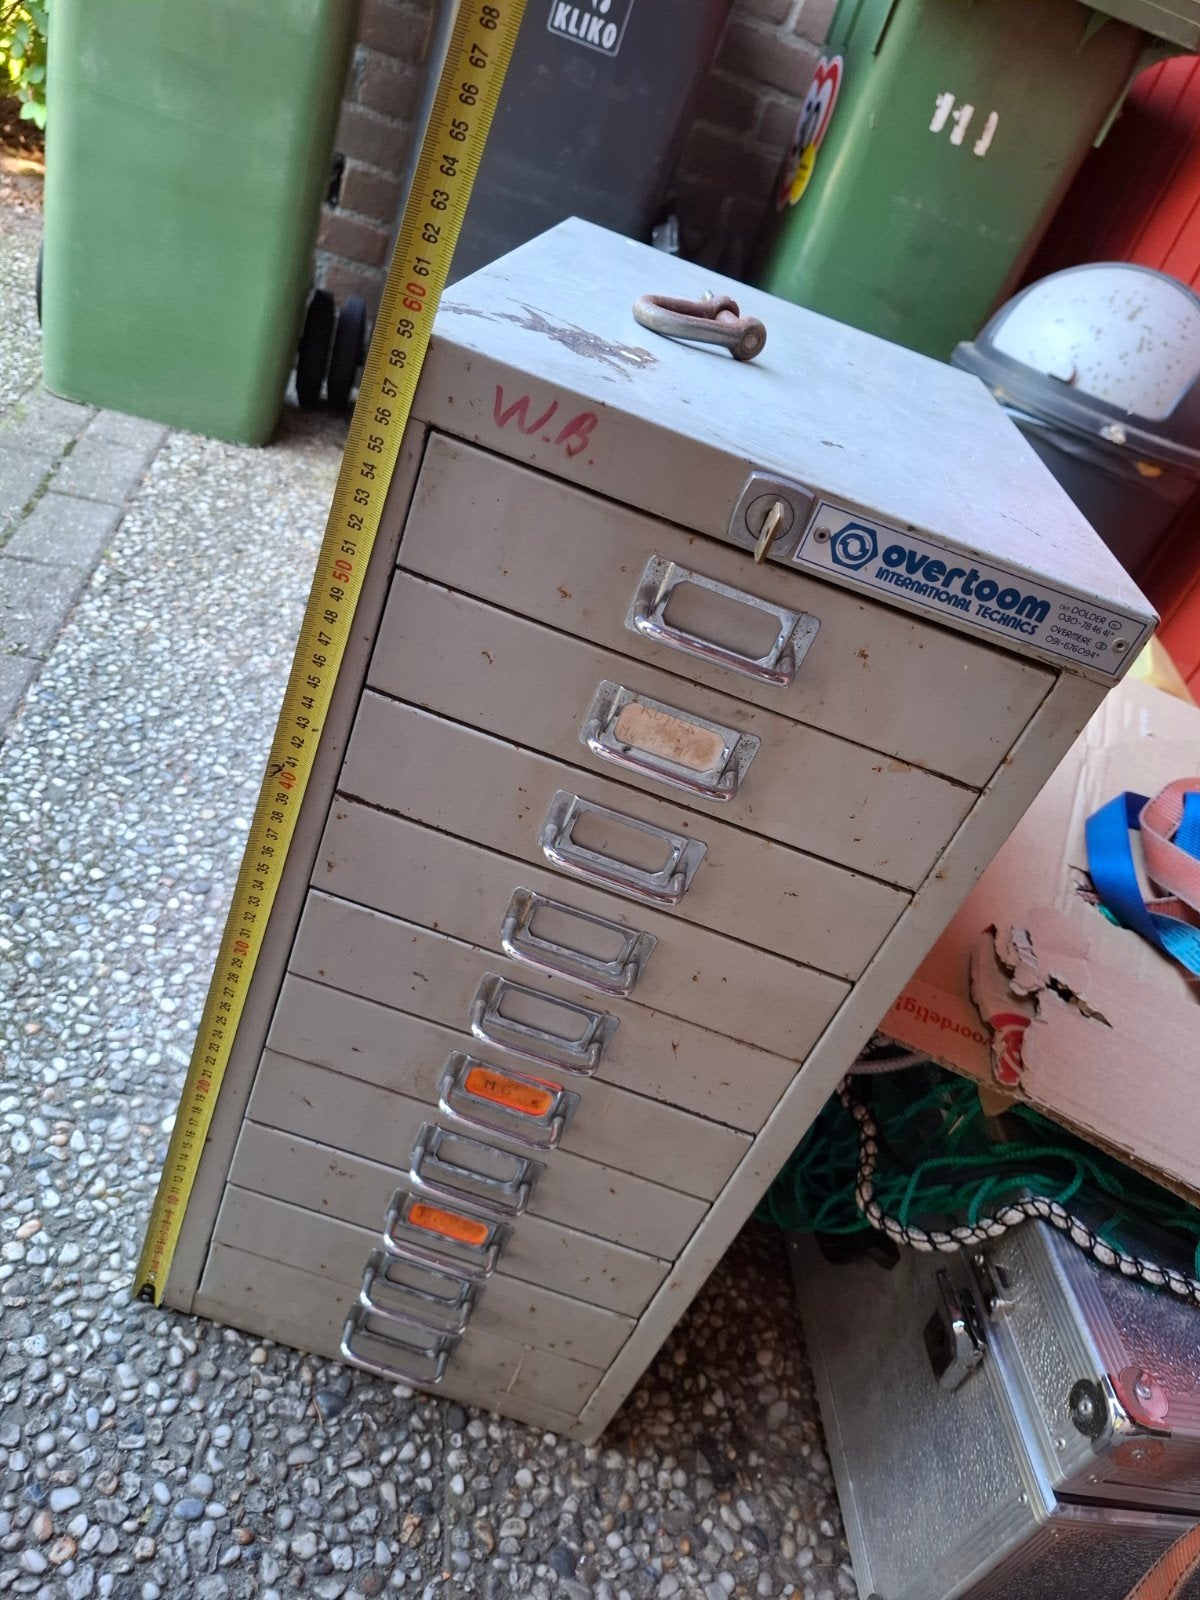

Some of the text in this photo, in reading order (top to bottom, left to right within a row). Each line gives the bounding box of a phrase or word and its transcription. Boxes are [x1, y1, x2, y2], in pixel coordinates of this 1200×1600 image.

[479, 5, 500, 30] 68
[553, 1, 618, 49] KLIKO
[469, 43, 489, 69] 67
[459, 82, 479, 106] 66
[449, 118, 469, 142] 65
[439, 154, 459, 177] 64
[431, 189, 450, 211] 63
[422, 222, 441, 244] 62
[413, 257, 431, 277] 61
[403, 282, 427, 312] 60
[397, 319, 414, 339] 59
[389, 349, 407, 369] 58
[381, 377, 399, 398] 57
[375, 406, 392, 426] 56
[367, 434, 384, 454] 55
[360, 462, 377, 480] 54
[354, 488, 370, 506] 53
[347, 513, 364, 531] 52
[341, 539, 356, 556] 51
[332, 559, 352, 583] 50
[882, 544, 1051, 623] overtoom
[329, 586, 344, 602] 49
[875, 566, 1039, 635] INTERNATIONAL TECHNICS
[323, 609, 338, 625] 48
[1071, 606, 1107, 624] DOLDER
[318, 631, 332, 647] 47
[1050, 625, 1093, 646] OVERMERE
[312, 653, 327, 668] 46
[307, 675, 321, 689] 45
[301, 696, 315, 710] 44
[296, 716, 310, 729] 43
[290, 735, 305, 749] 42
[285, 755, 299, 768] 41
[279, 771, 296, 790] 40
[275, 792, 289, 805] 39
[271, 810, 284, 823] 38
[266, 828, 279, 840] 37
[261, 845, 275, 858] 36
[256, 862, 270, 875] 35
[252, 879, 265, 891] 34
[248, 895, 260, 907] 33
[243, 911, 257, 923] 32
[239, 928, 252, 939] 31
[233, 940, 250, 957] 30
[231, 957, 244, 969] 29
[227, 972, 239, 984] 28
[223, 987, 235, 998] 27
[219, 1001, 232, 1012] 26
[216, 1015, 228, 1026] 25
[212, 1029, 223, 1040] 24
[208, 1042, 220, 1053] 23
[205, 1055, 217, 1066] 22
[201, 1069, 213, 1079] 21
[196, 1080, 211, 1094] 20
[195, 1094, 206, 1102] 19
[191, 1106, 203, 1114] 18
[189, 1118, 199, 1126] 17
[185, 1130, 197, 1138] 16
[182, 1141, 193, 1150] 15
[179, 1153, 189, 1161] 14
[176, 1164, 187, 1172] 13
[173, 1175, 184, 1183] 12
[166, 1195, 180, 1205] 10
